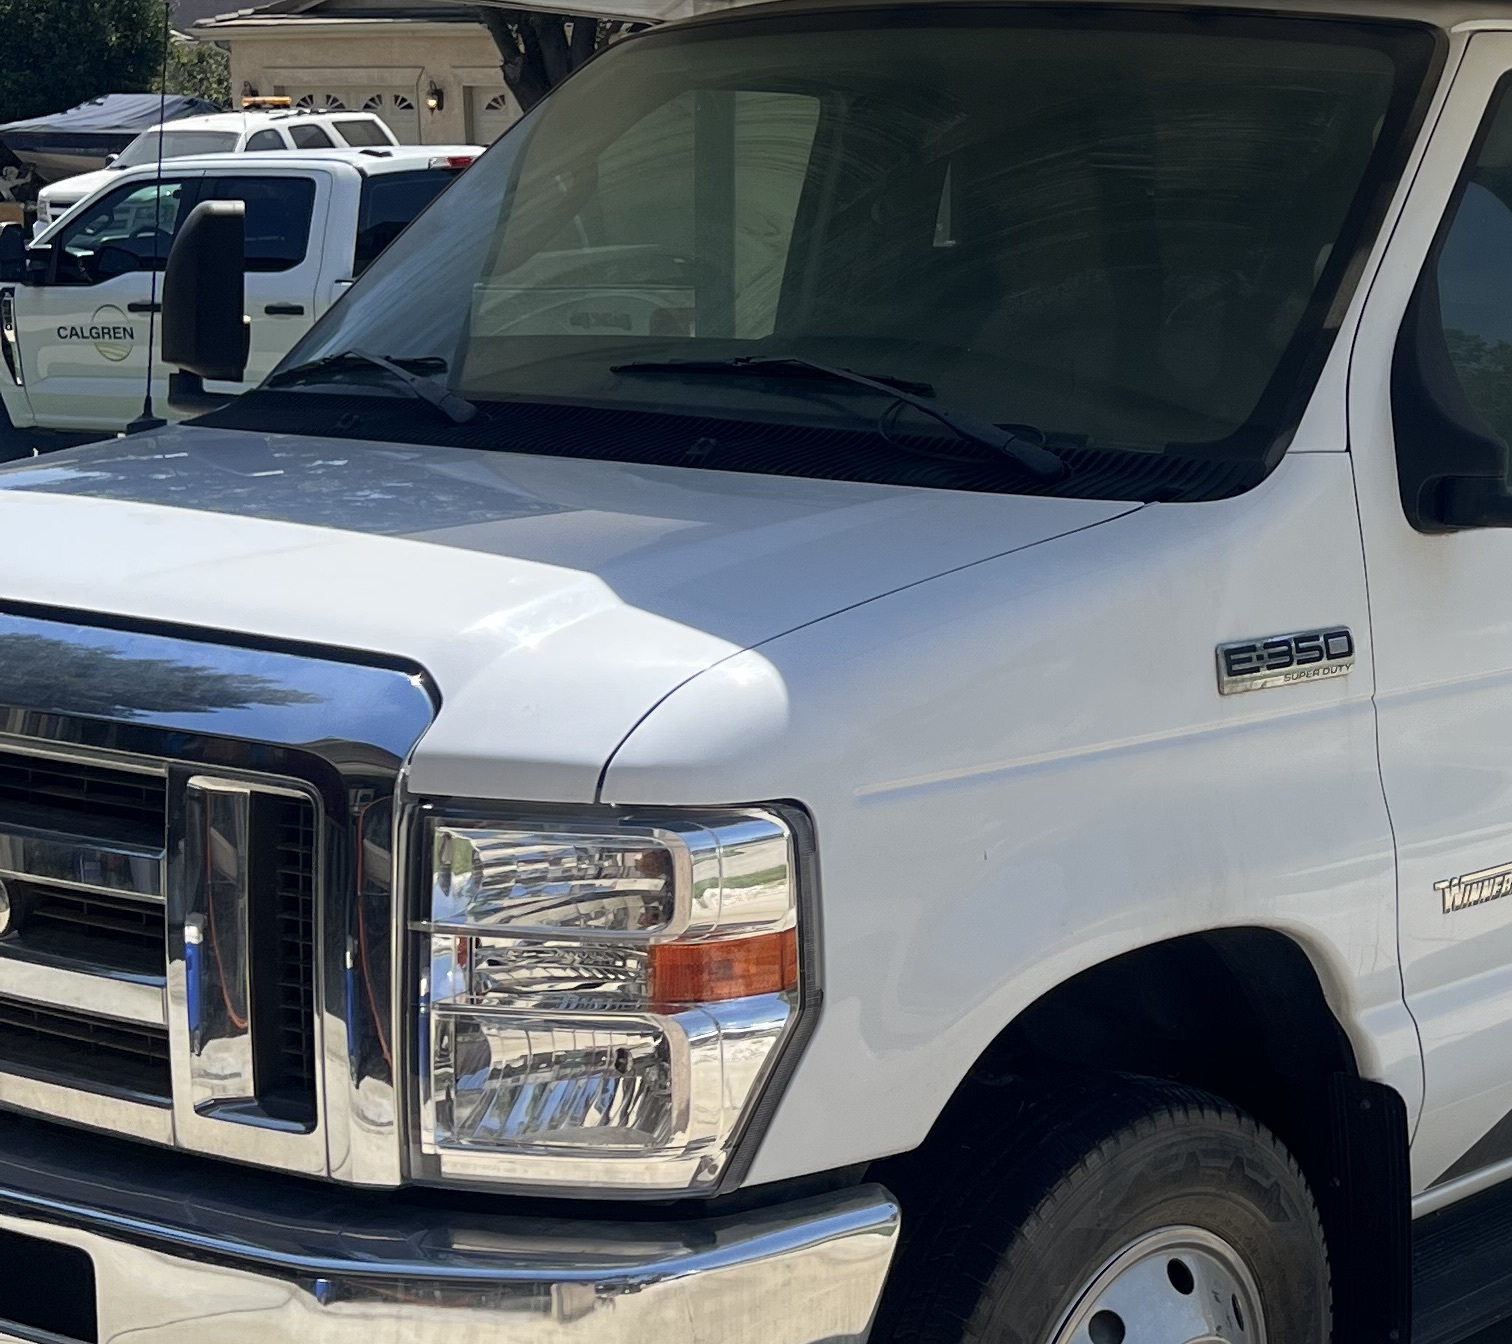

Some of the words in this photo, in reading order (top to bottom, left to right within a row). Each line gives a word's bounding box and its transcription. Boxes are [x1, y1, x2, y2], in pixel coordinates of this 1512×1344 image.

[56, 326, 135, 340] CALGREN
[1283, 669, 1321, 682] SUPER
[1322, 664, 1352, 676] DUTY
